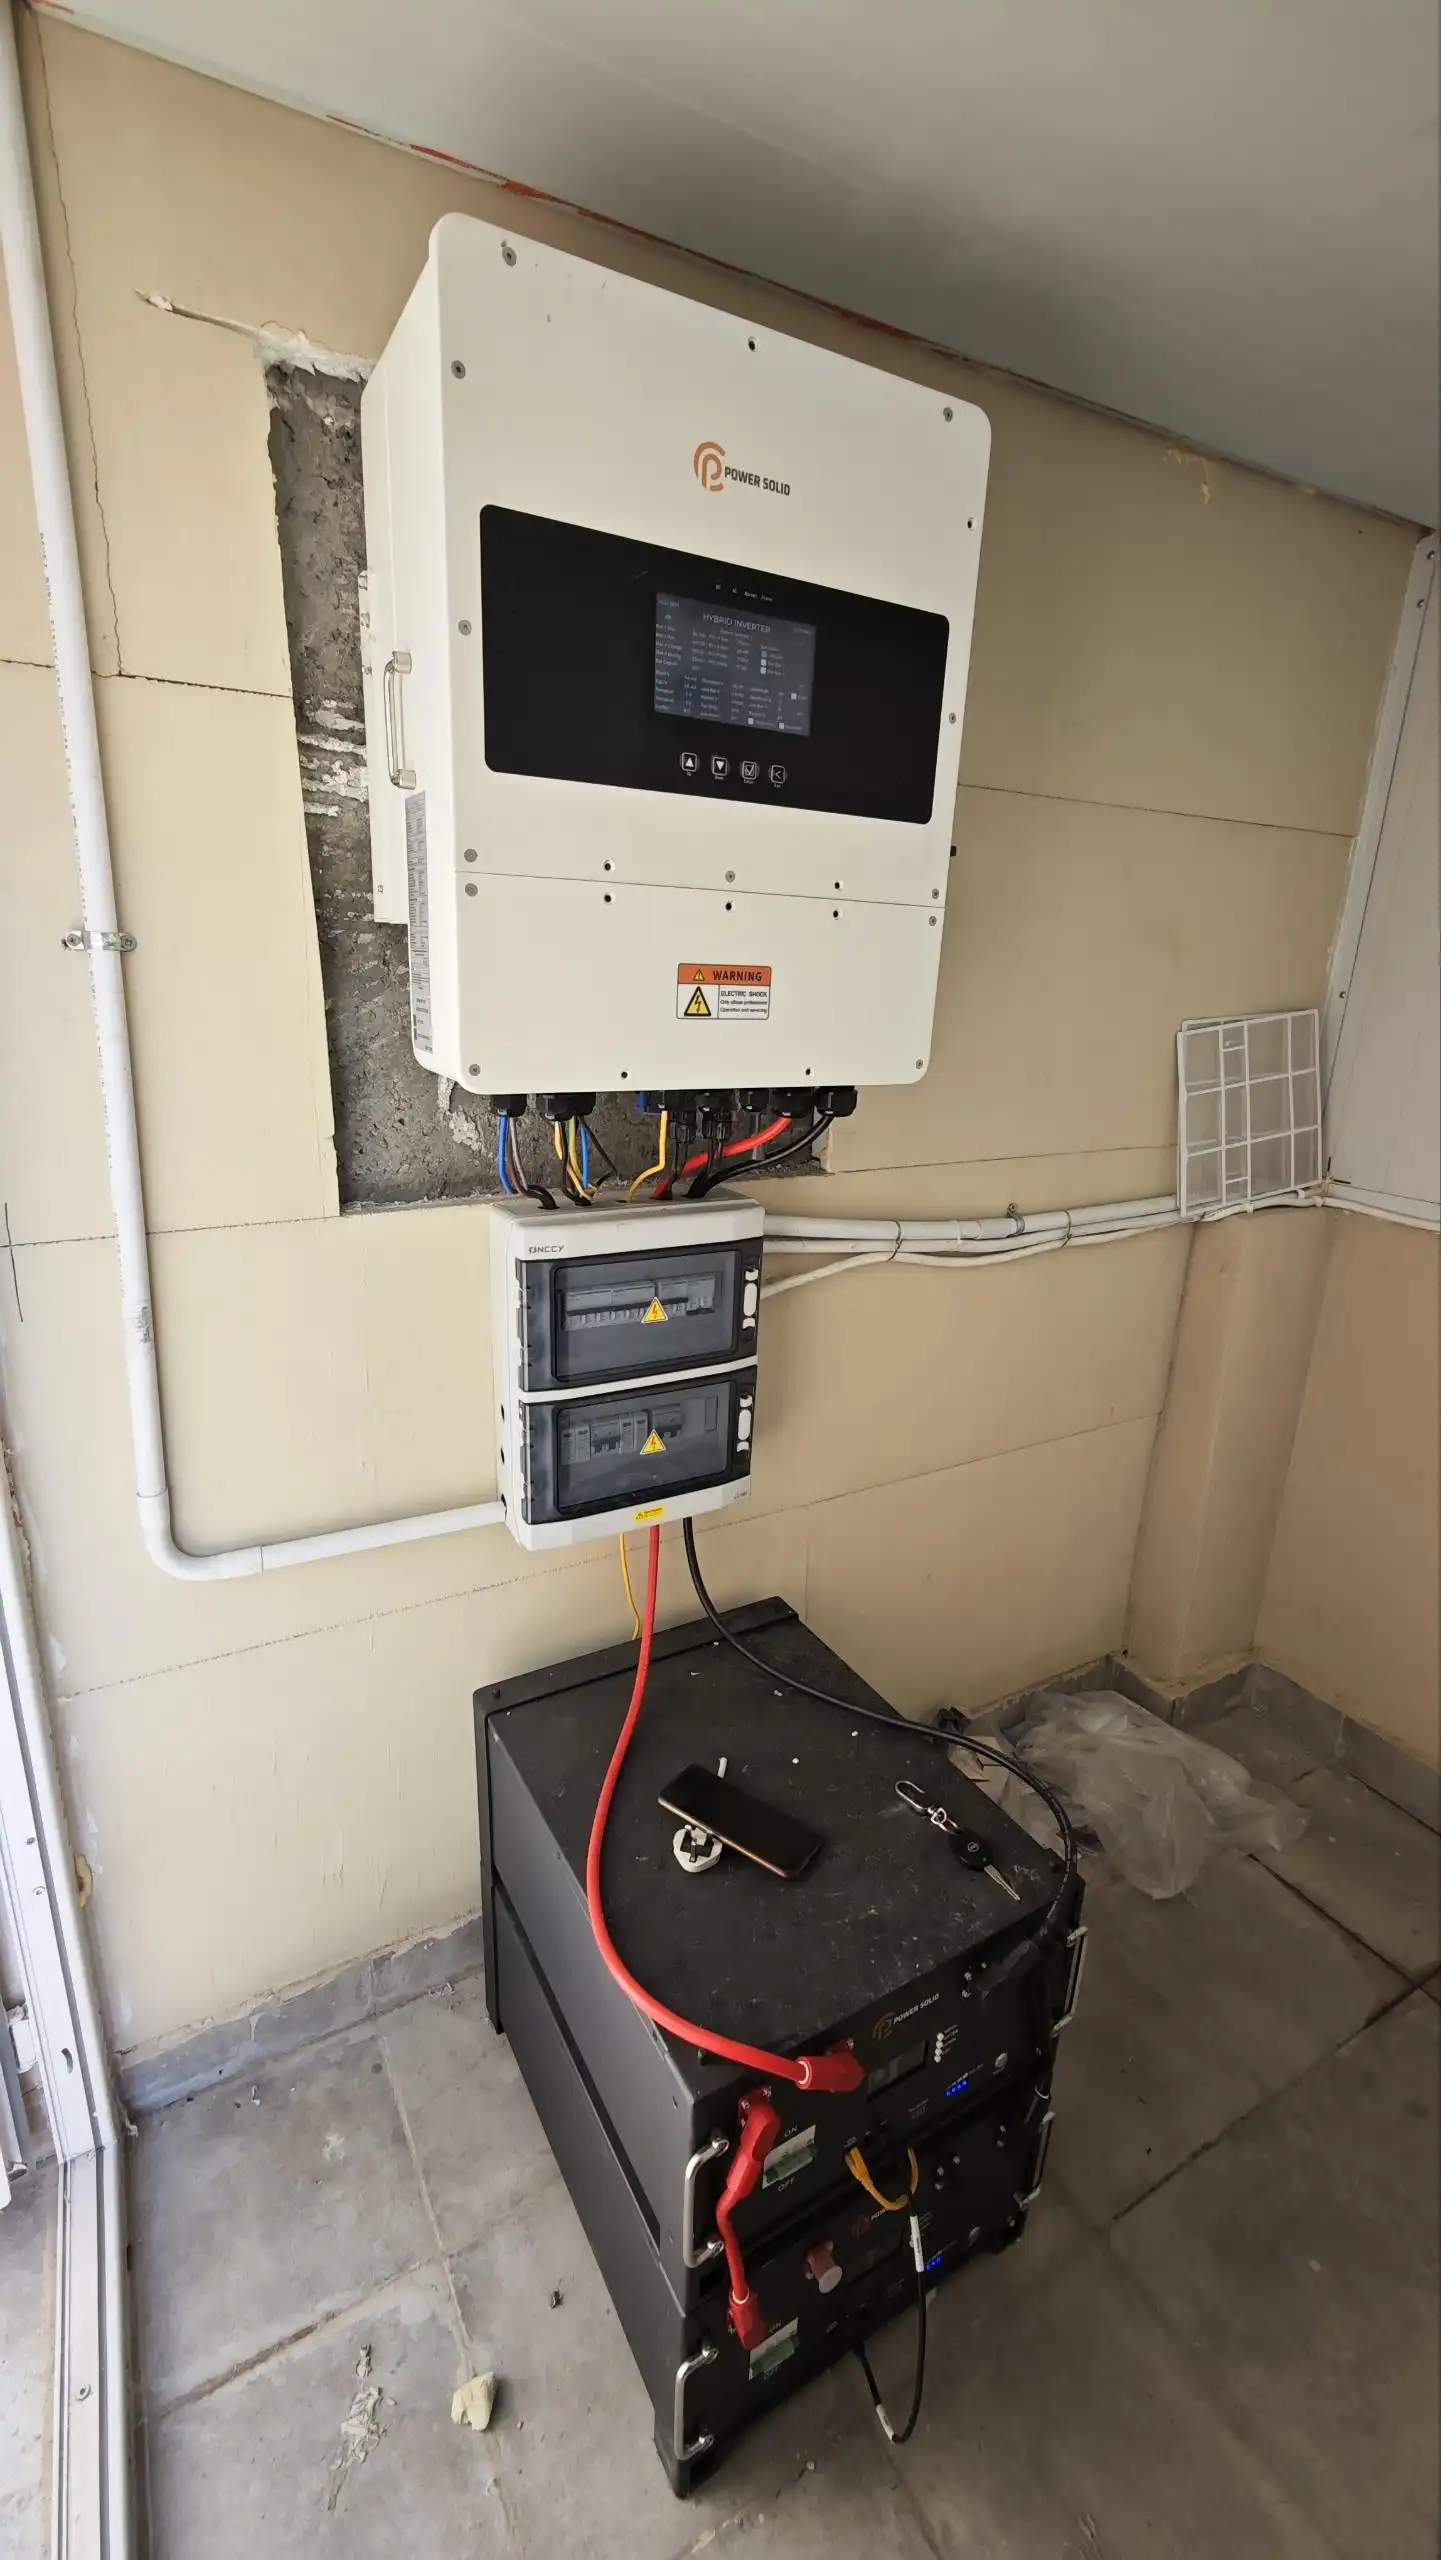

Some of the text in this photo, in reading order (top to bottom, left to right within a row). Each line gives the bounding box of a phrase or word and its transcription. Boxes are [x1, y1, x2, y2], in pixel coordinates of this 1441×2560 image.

[725, 466, 791, 496] POWER SOLID
[703, 612, 771, 633] HYBRID INVERTER
[713, 970, 762, 982] WARNING
[720, 990, 768, 998] ELECTRIC SHOCK
[893, 1993, 940, 2024] POWER SOLID
[784, 2126, 798, 2138] ON
[777, 2176, 795, 2193] OFF
